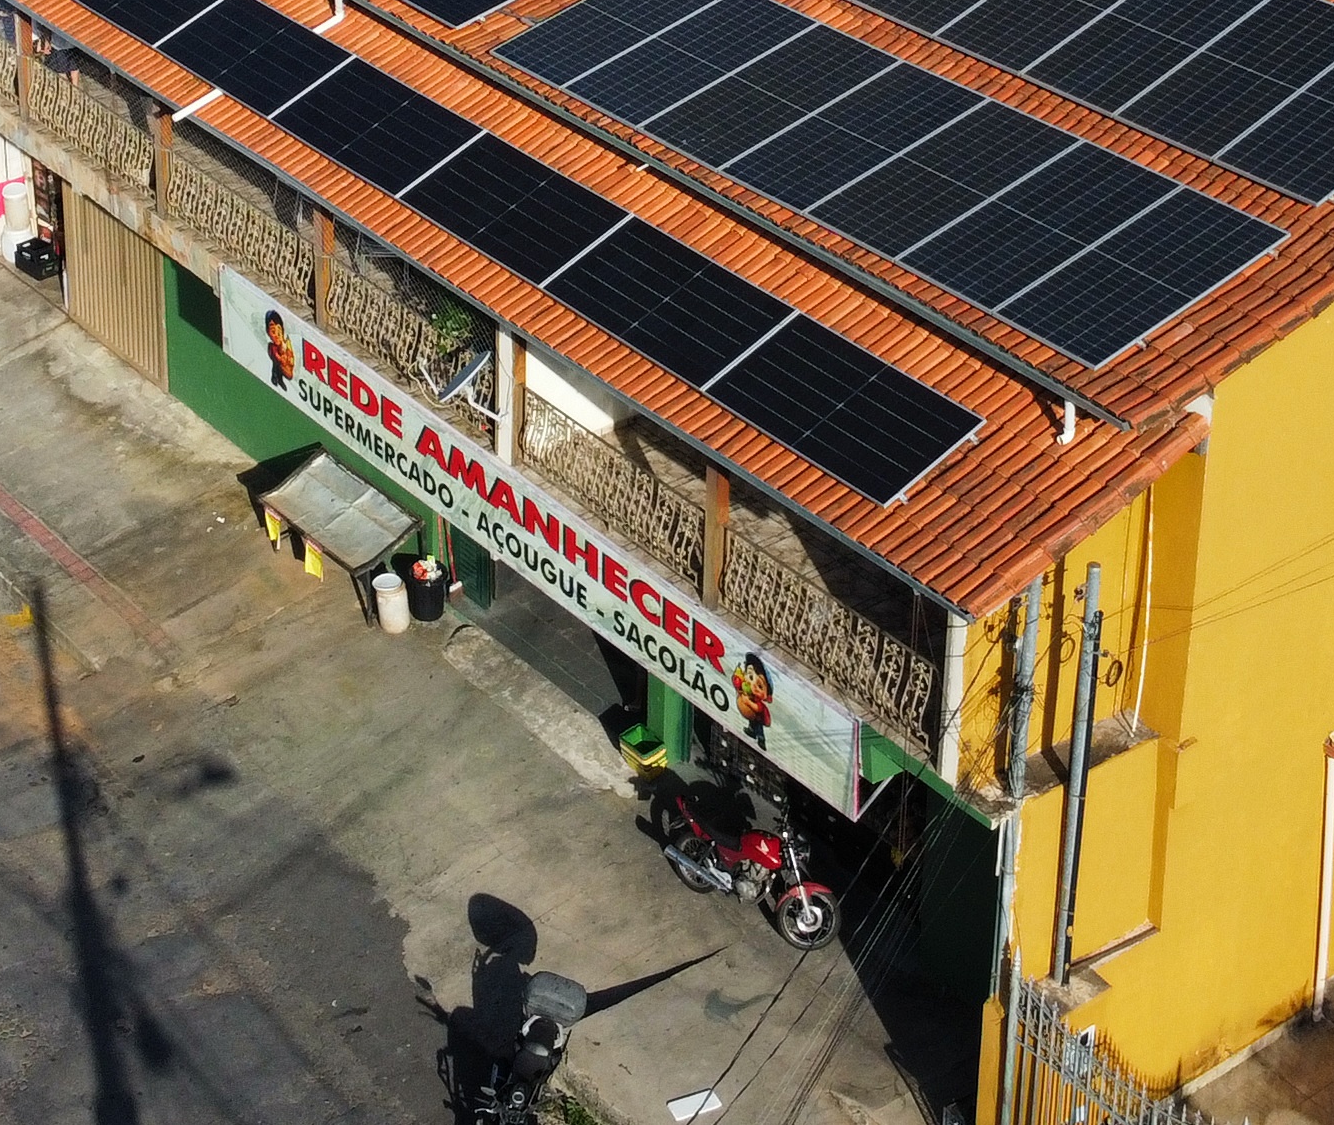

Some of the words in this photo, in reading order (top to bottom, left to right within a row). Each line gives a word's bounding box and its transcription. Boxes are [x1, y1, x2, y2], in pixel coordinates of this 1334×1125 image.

[298, 379, 454, 509] SUPERMERCADO
[477, 512, 588, 610] AÇOUGUE
[613, 610, 730, 712] SACOLÃO
[302, 338, 403, 439] REDE
[415, 424, 726, 675] AMANHECER
